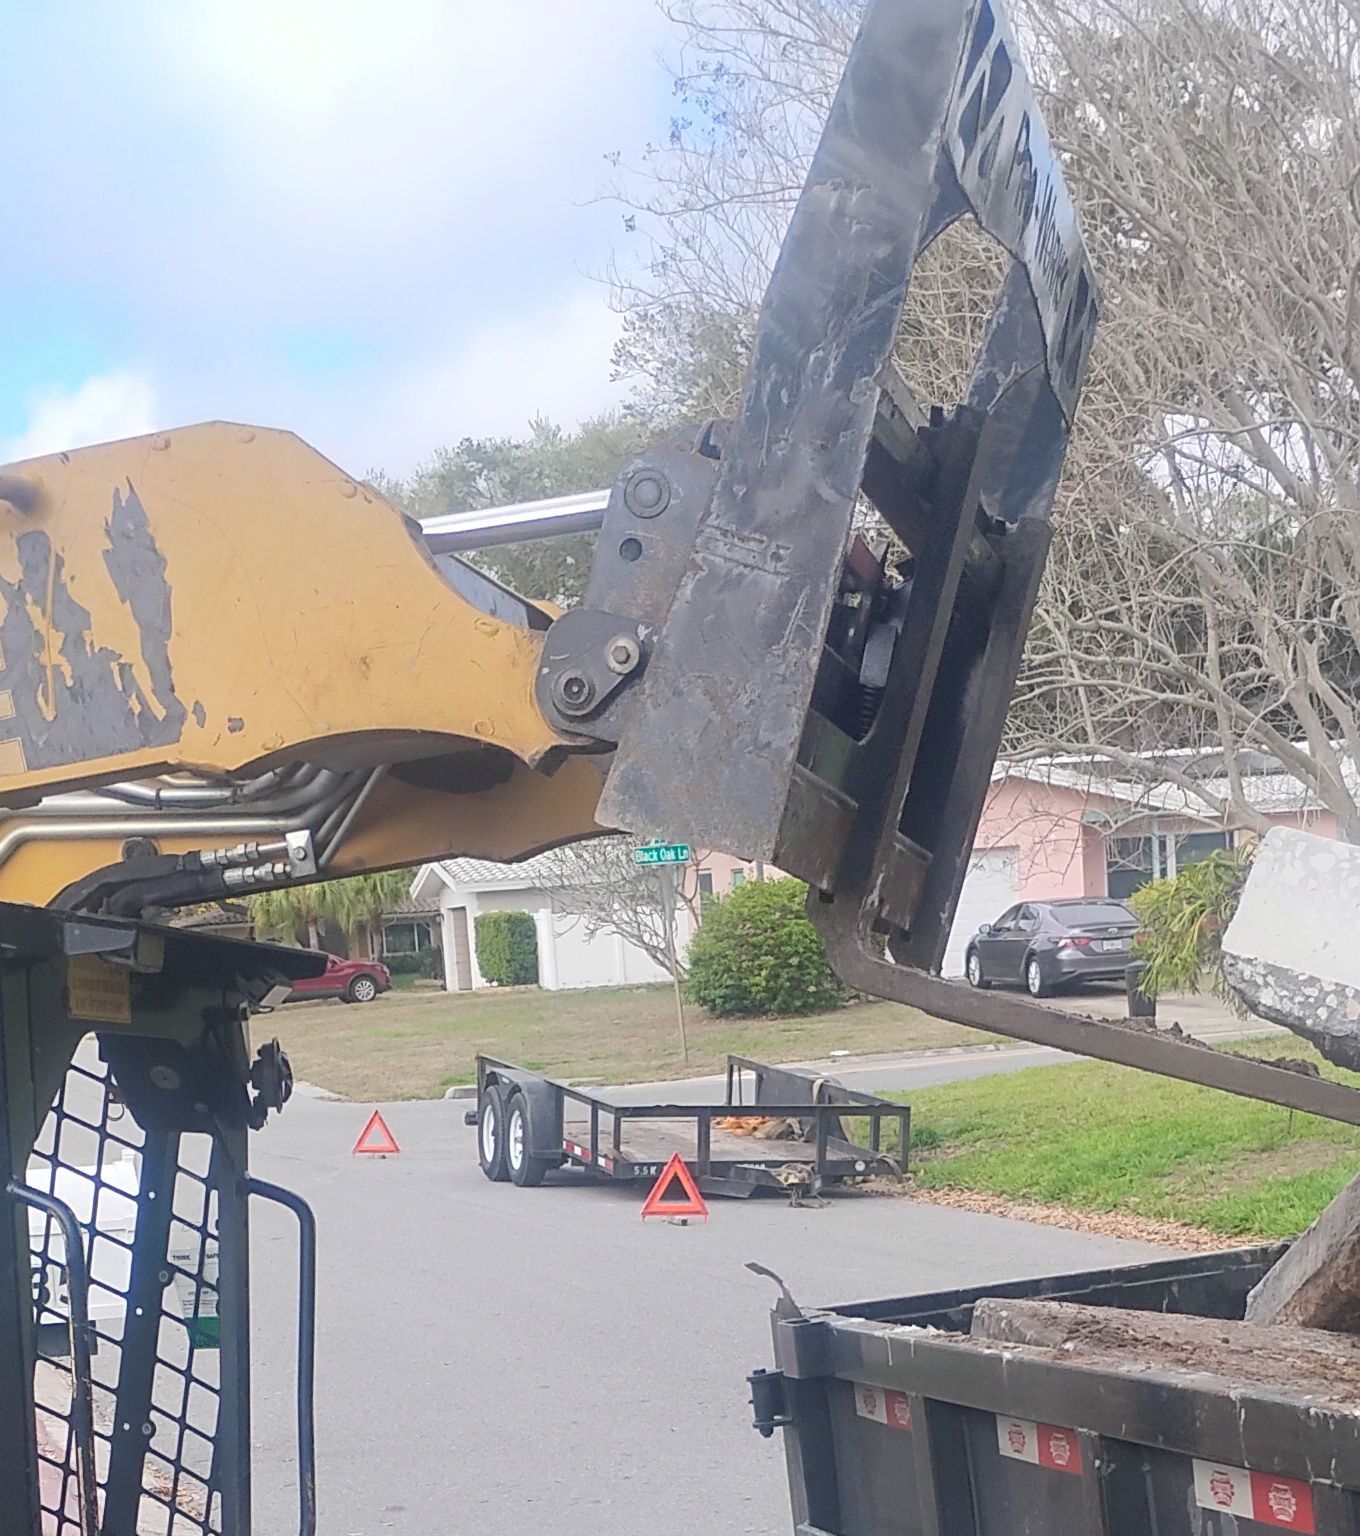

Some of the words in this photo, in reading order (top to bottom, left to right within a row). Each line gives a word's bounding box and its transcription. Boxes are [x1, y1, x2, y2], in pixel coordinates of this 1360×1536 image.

[635, 849, 658, 862] Black
[660, 848, 676, 861] Oak
[677, 847, 689, 860] Ln
